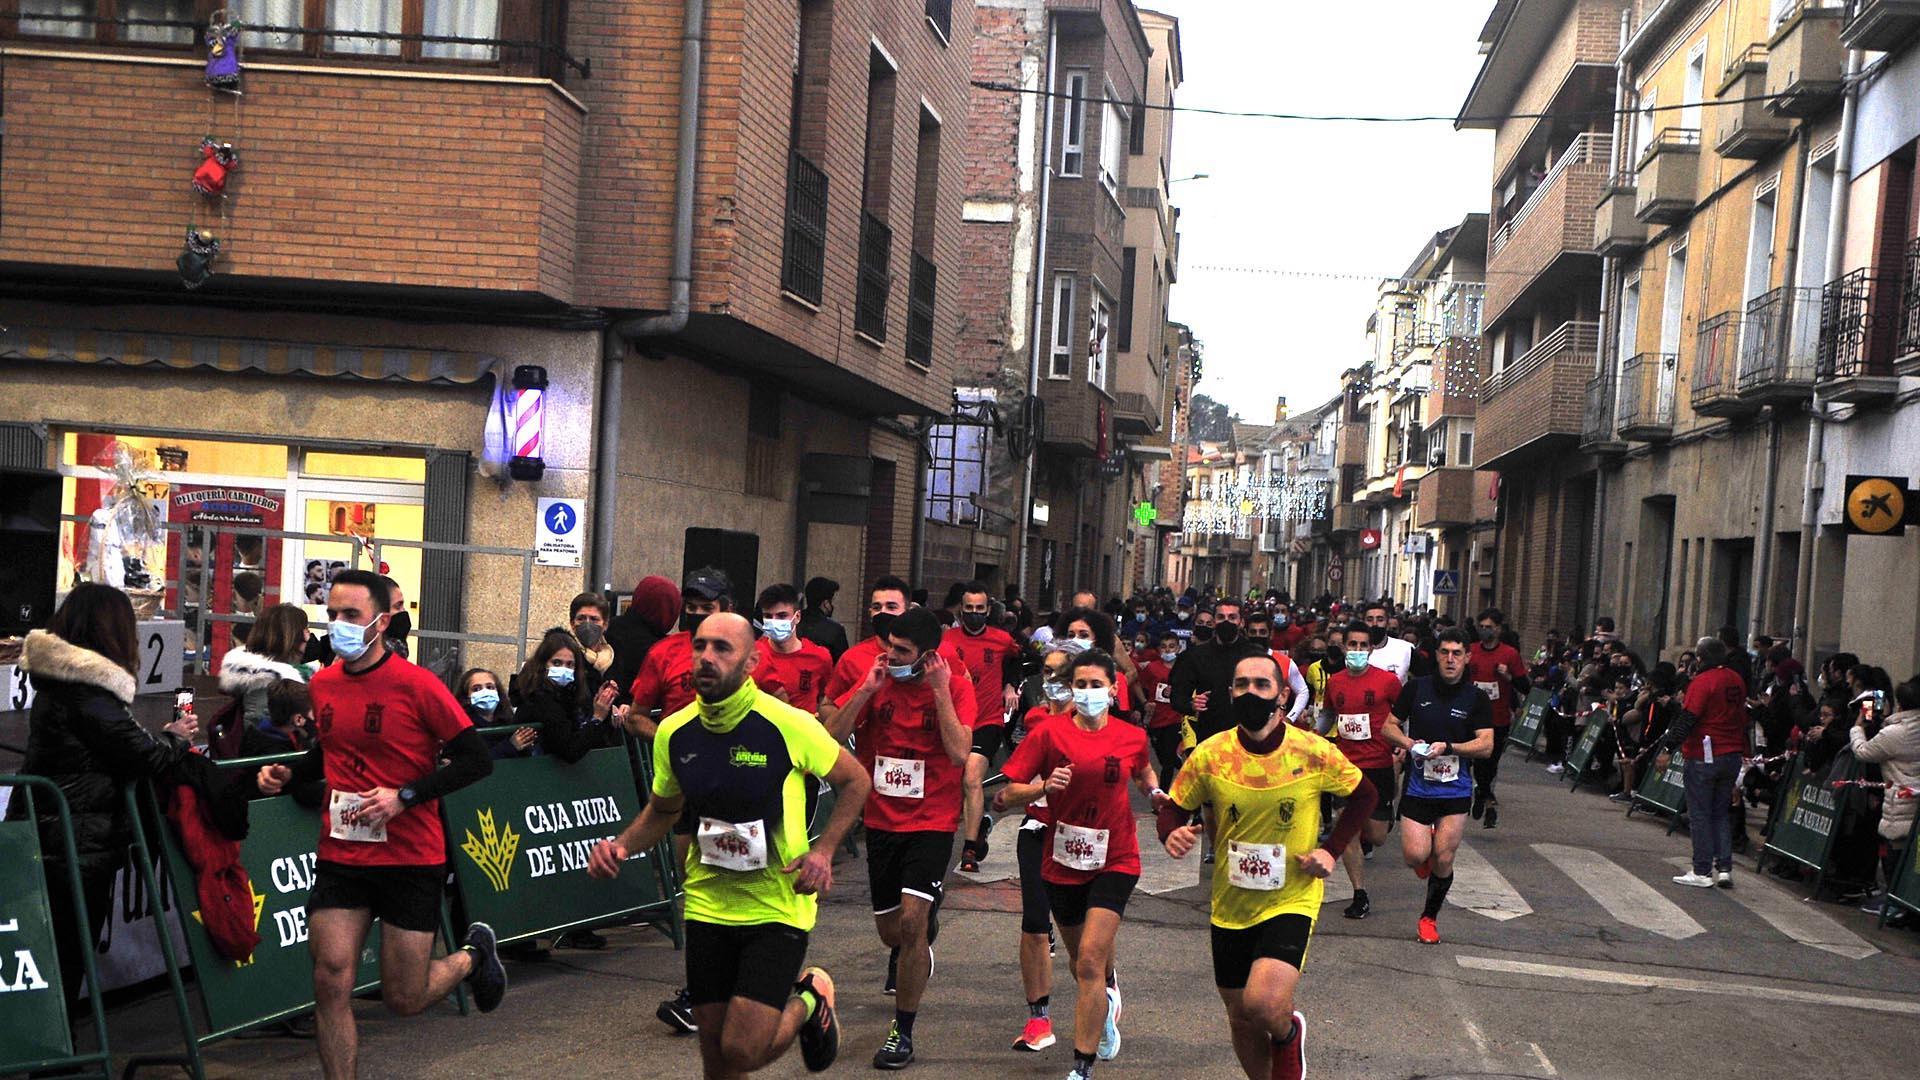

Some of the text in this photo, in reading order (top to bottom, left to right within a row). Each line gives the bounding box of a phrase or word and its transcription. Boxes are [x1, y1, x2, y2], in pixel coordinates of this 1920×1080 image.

[227, 490, 280, 511] CABALLEROS
[145, 632, 165, 685] 2
[13, 663, 29, 710] 3
[525, 801, 574, 834] CAJA
[526, 844, 556, 878] DE
[273, 906, 309, 948] DE
